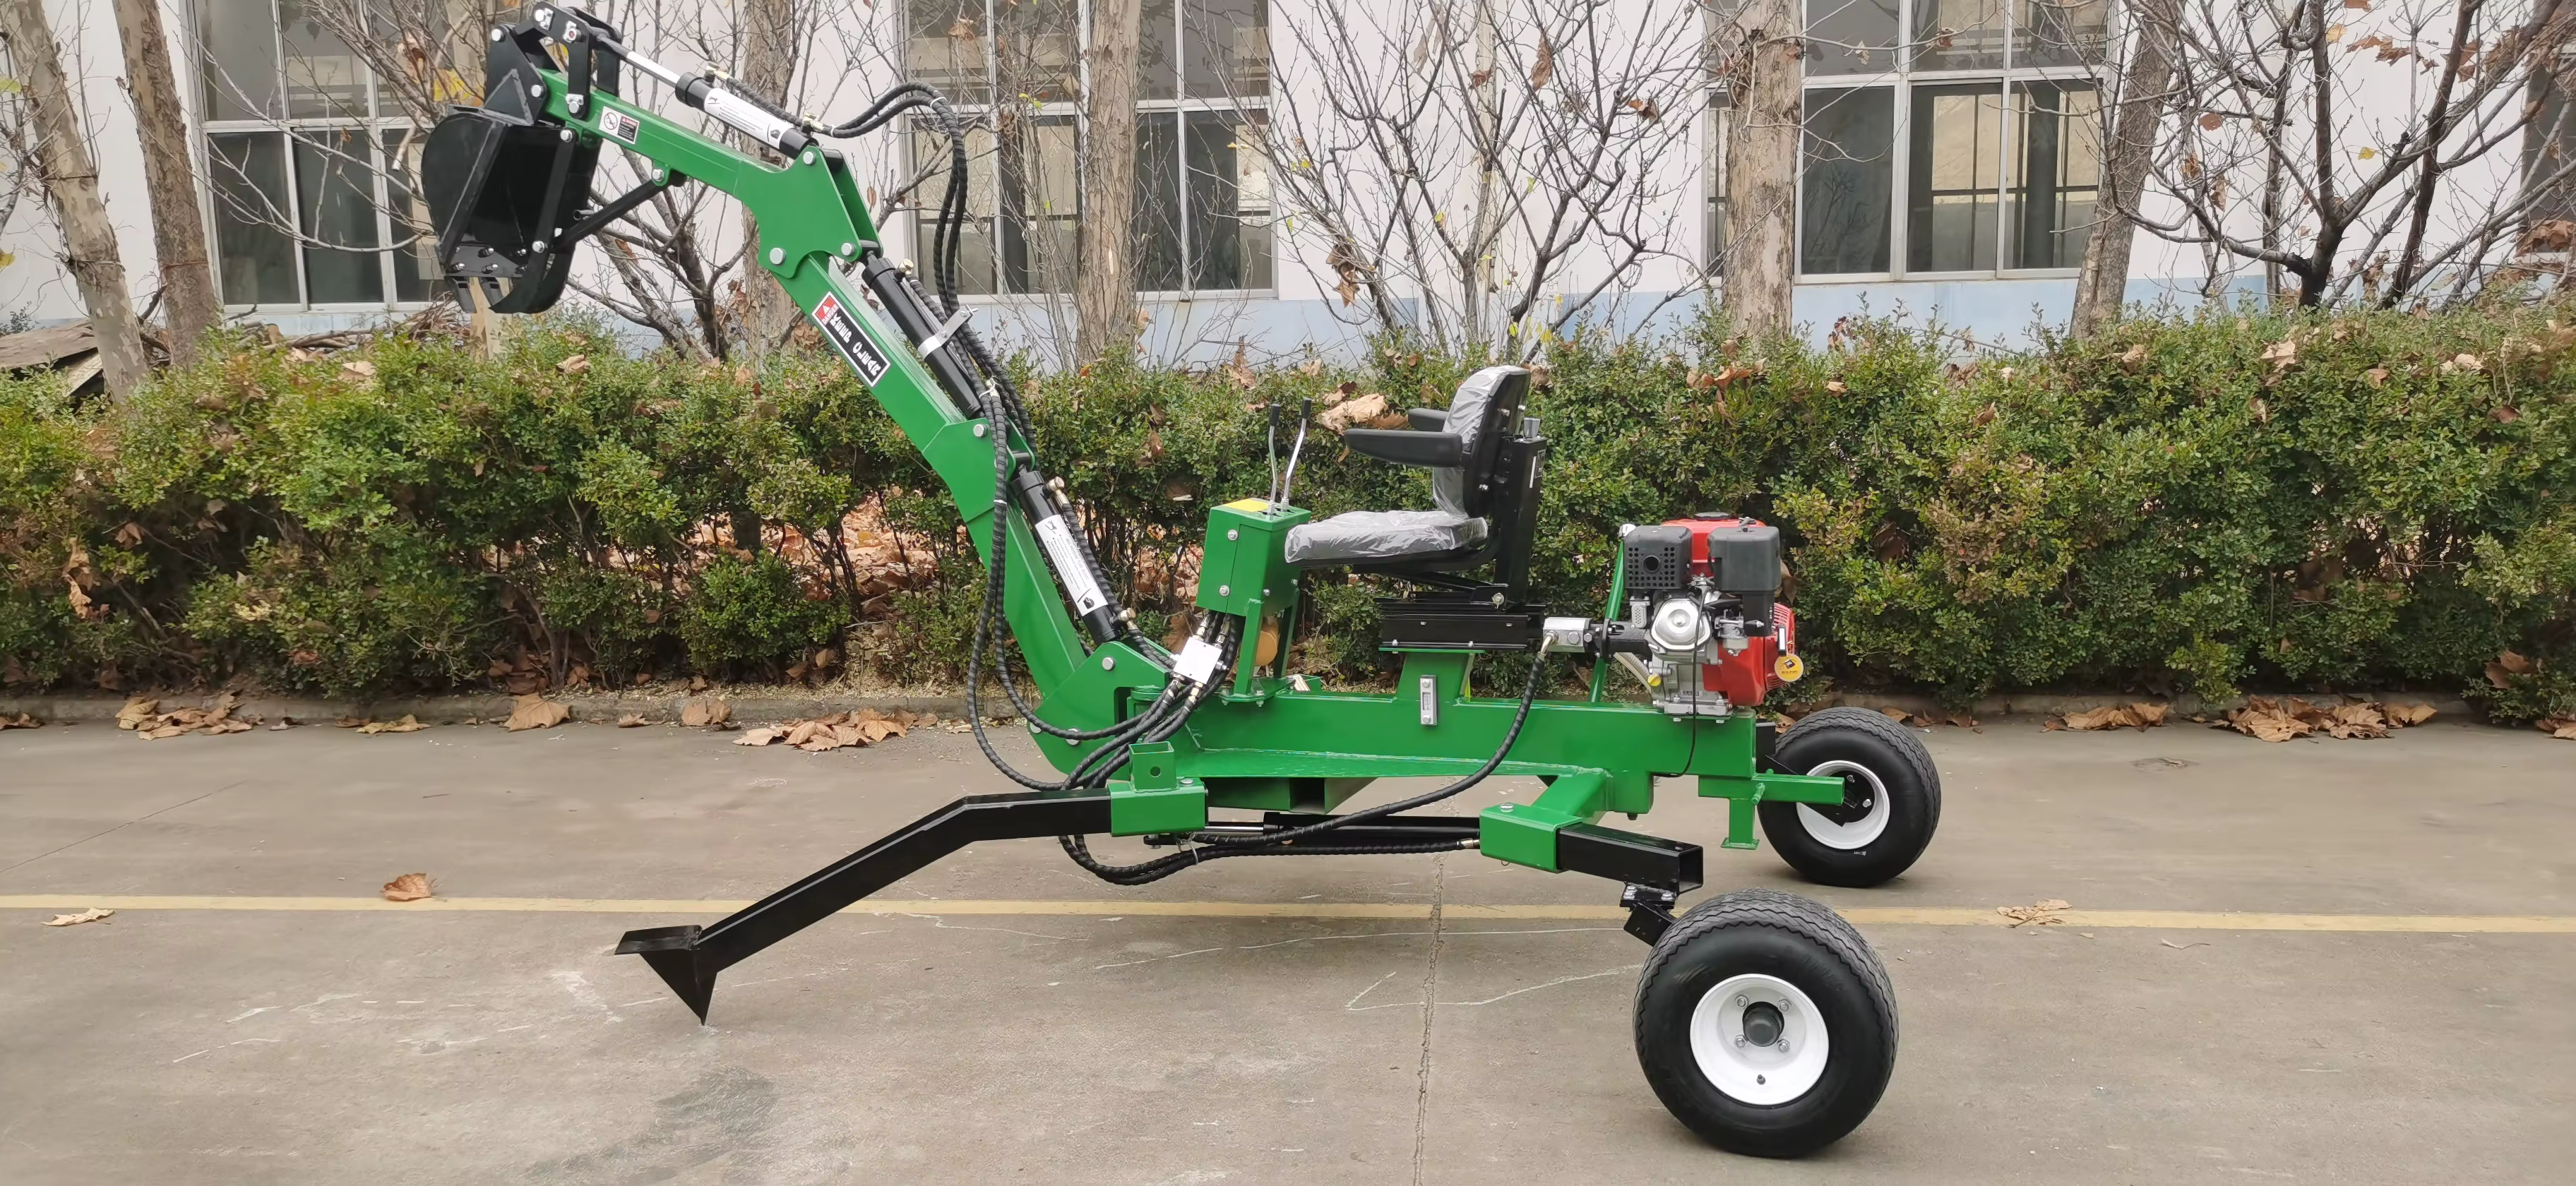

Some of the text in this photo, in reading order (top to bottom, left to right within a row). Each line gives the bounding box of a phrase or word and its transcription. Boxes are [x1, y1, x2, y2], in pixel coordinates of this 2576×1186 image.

[822, 304, 839, 325] DANGER
[830, 313, 881, 376] KEEP CLEAR
